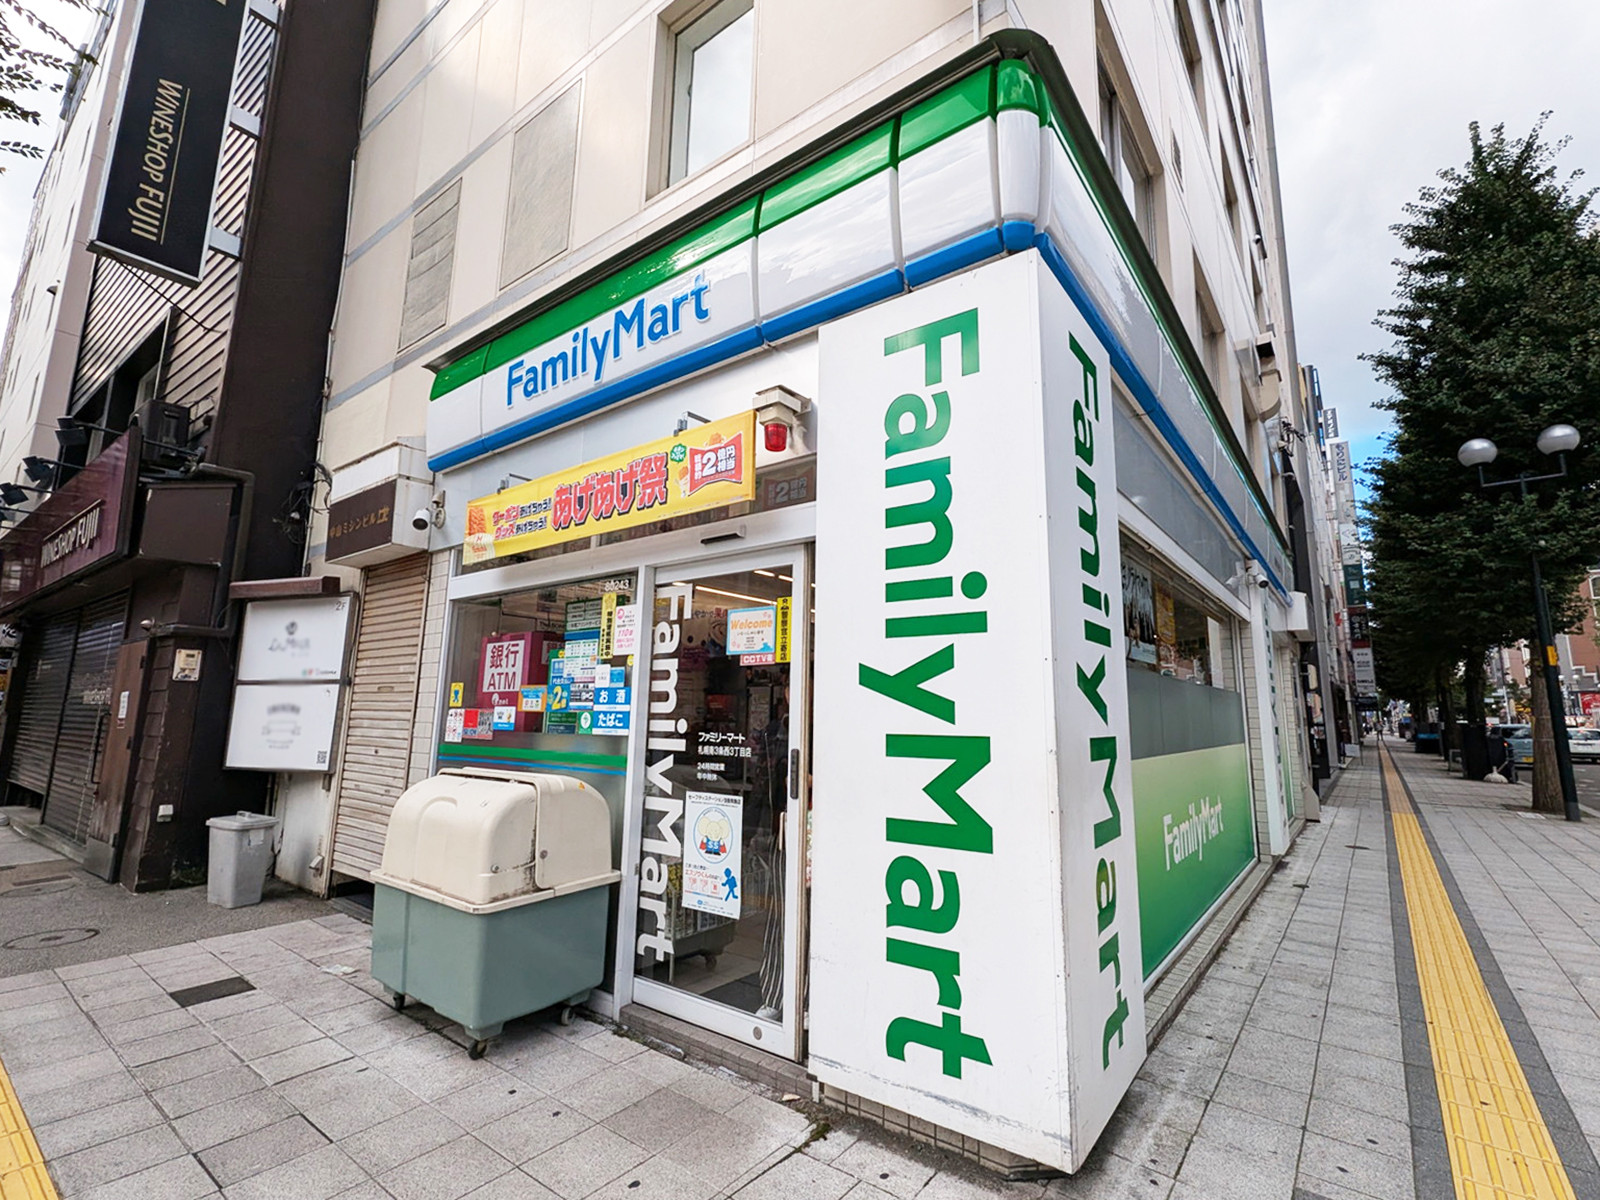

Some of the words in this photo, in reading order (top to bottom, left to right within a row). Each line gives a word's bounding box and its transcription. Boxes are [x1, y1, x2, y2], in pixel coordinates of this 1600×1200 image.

[142, 78, 183, 184] WINESHOP
[127, 182, 165, 241] FUJII
[506, 274, 712, 407] FamilyMart
[701, 451, 717, 477] 2
[551, 452, 669, 531] あげあげ祭
[335, 601, 346, 611] 2F
[730, 619, 773, 630] Welcome
[490, 643, 520, 669] 銀行
[487, 671, 516, 690] ATM
[599, 689, 626, 703] お酒
[858, 307, 994, 1079] FamilyMart
[1068, 331, 1130, 1071] FamilyMart
[597, 712, 624, 727] たばこ
[698, 731, 746, 744] ファミリーマート
[636, 583, 693, 962] FamilyMart
[1163, 795, 1223, 871] FamilyMart
